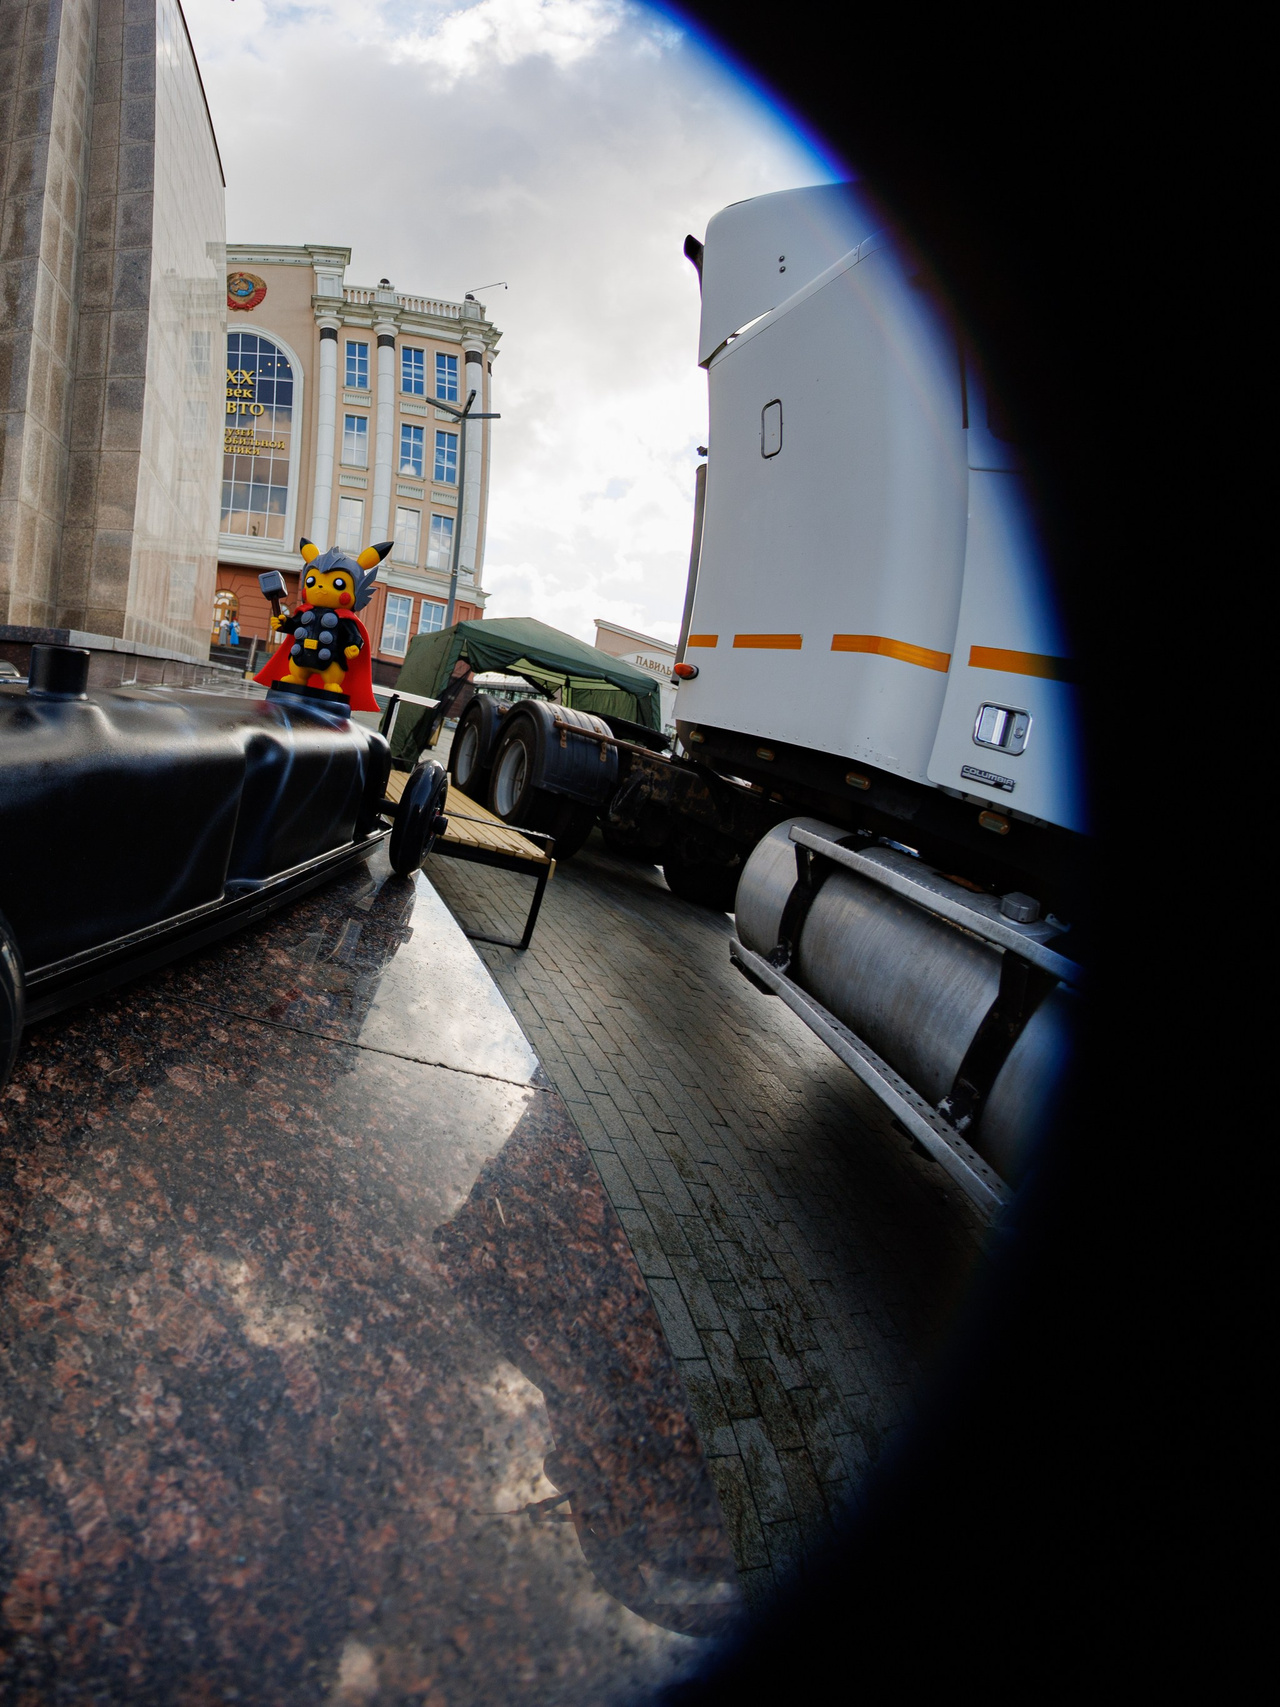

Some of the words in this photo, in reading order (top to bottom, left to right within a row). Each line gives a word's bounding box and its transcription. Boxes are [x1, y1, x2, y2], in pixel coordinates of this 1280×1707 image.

[226, 402, 265, 416] ВТО
[225, 428, 254, 438] УЗЕЙ
[635, 655, 672, 676] ПАВИЛЬ
[963, 766, 1014, 786] COLUMBIA
